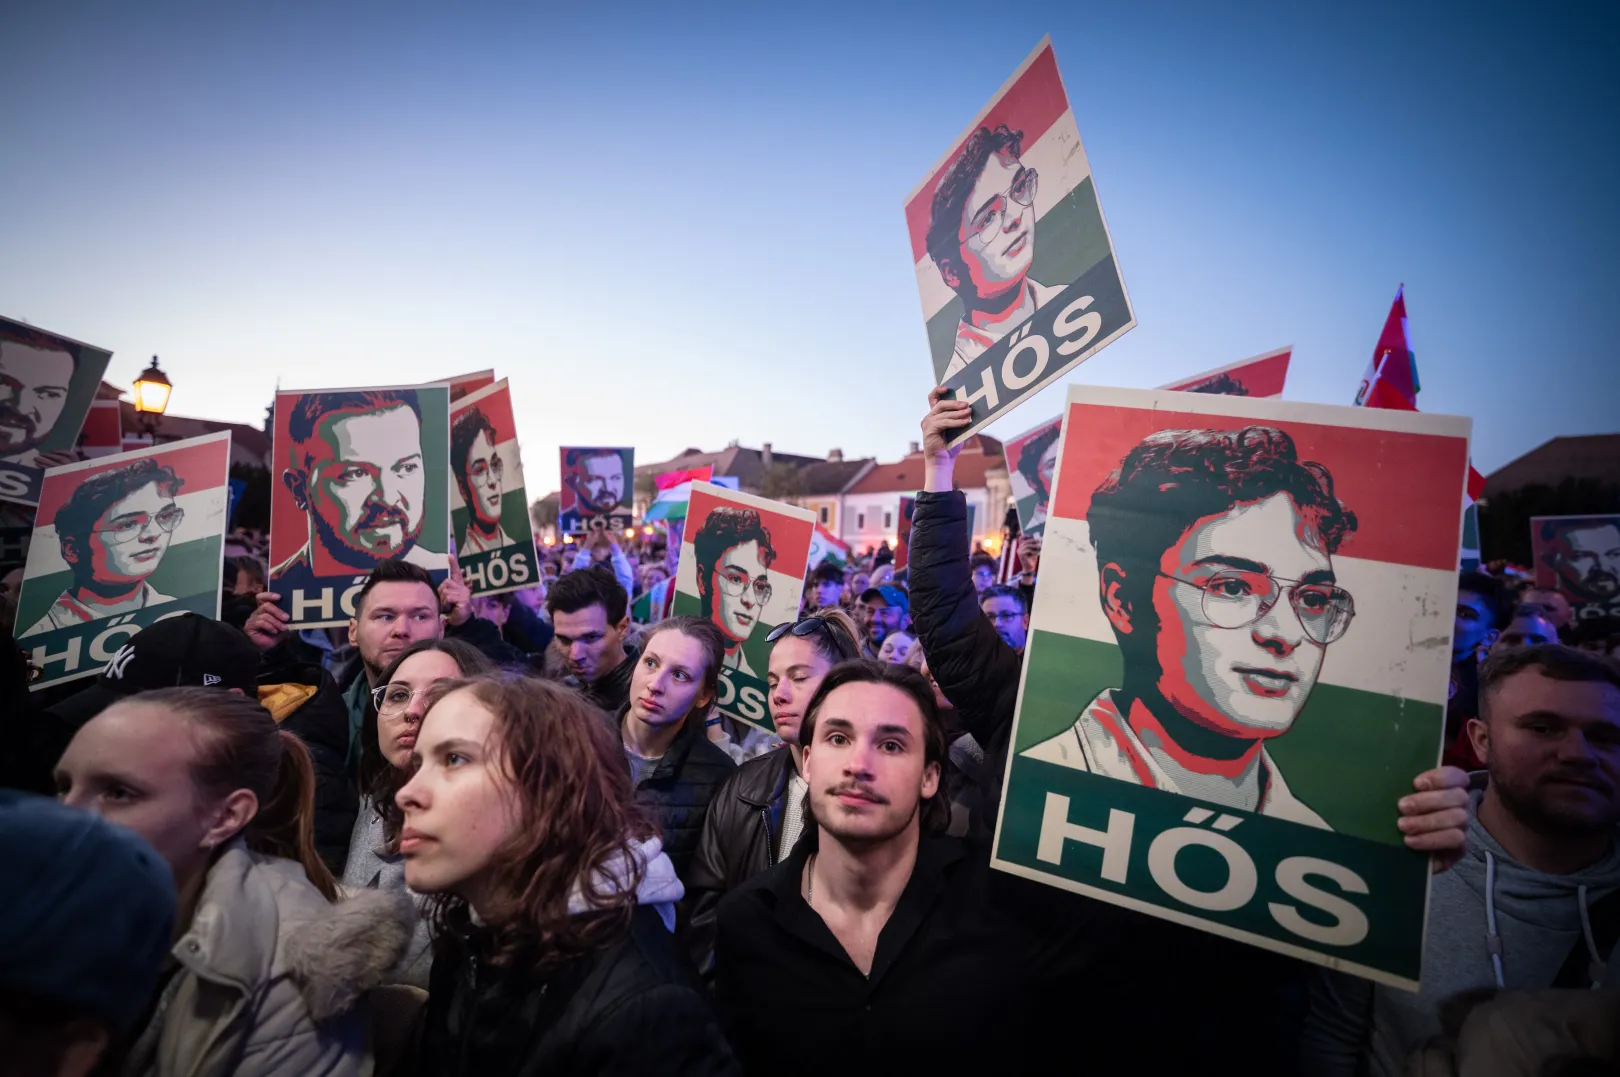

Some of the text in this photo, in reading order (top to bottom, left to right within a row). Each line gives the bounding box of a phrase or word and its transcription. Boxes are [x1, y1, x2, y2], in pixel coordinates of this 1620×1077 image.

[955, 295, 1102, 411] HŐS
[570, 514, 624, 531] HŐS
[465, 550, 529, 589] HŐS
[32, 609, 192, 672] HŐ
[717, 667, 767, 720] ŐS
[1036, 791, 1369, 947] HŐS
